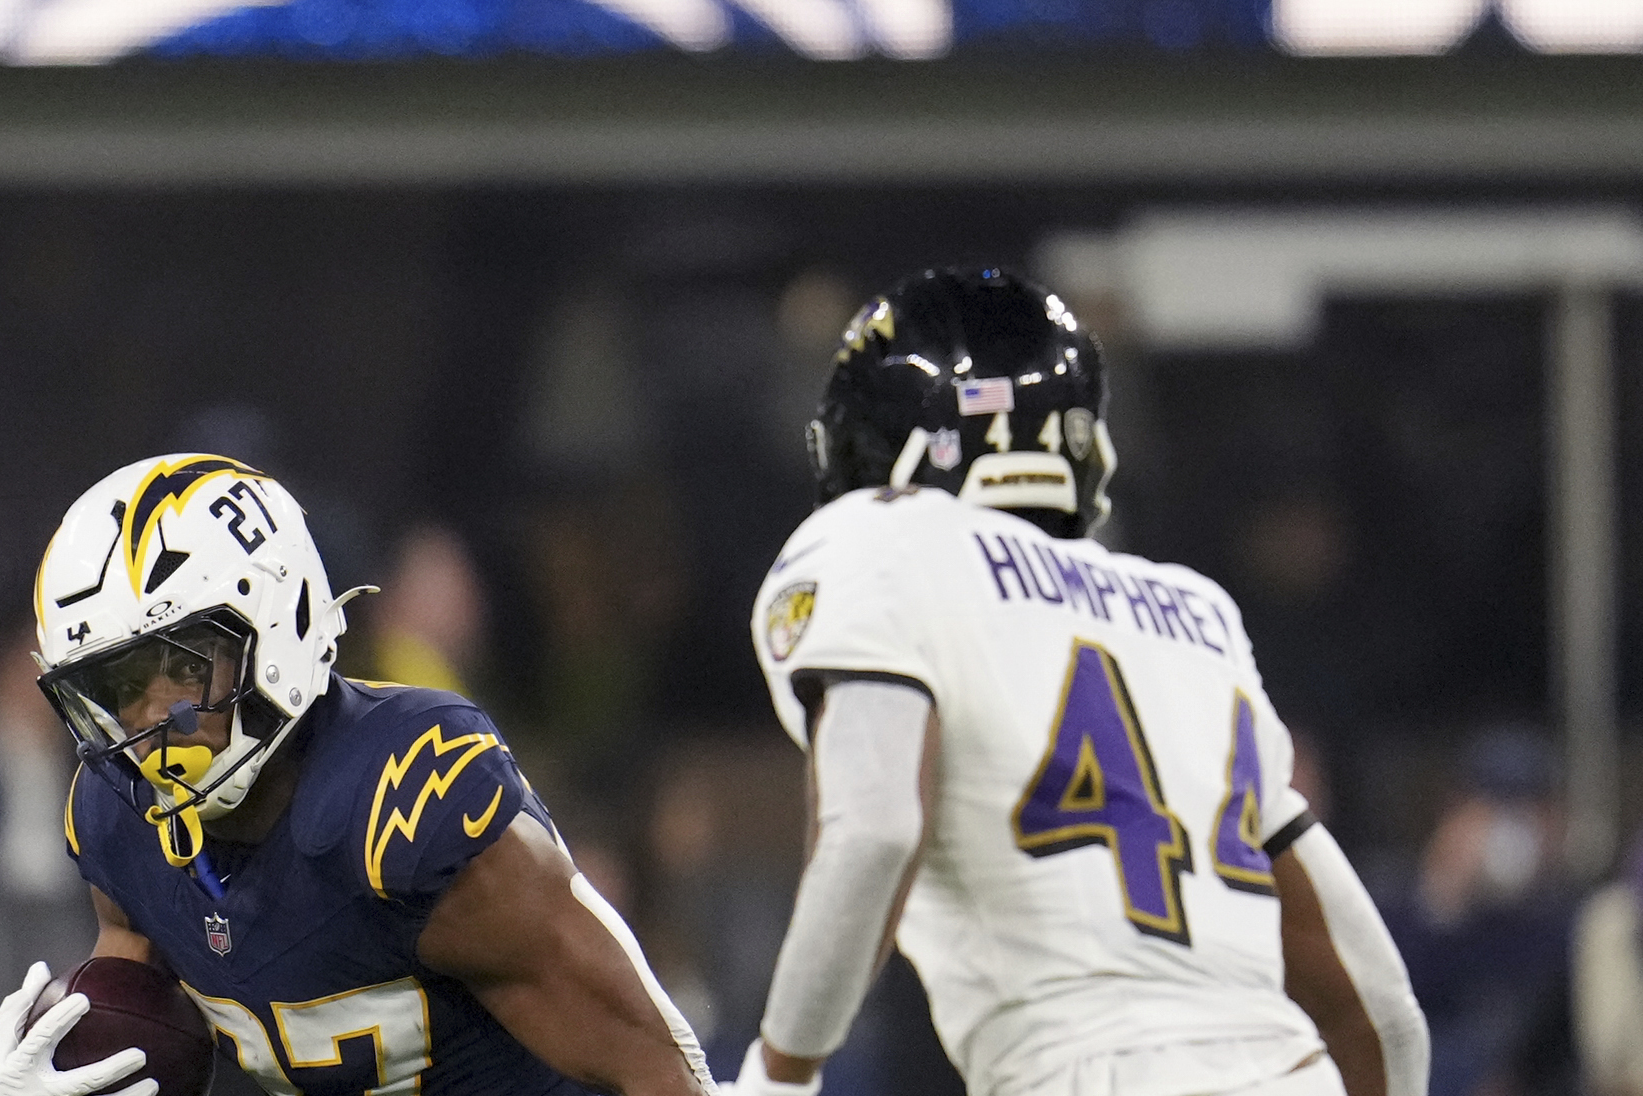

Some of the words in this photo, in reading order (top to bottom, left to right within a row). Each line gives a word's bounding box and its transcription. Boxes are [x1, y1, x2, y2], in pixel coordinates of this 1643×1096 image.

[209, 481, 278, 555] 27
[143, 604, 182, 629] OAKLEY
[1011, 635, 1280, 949] 44
